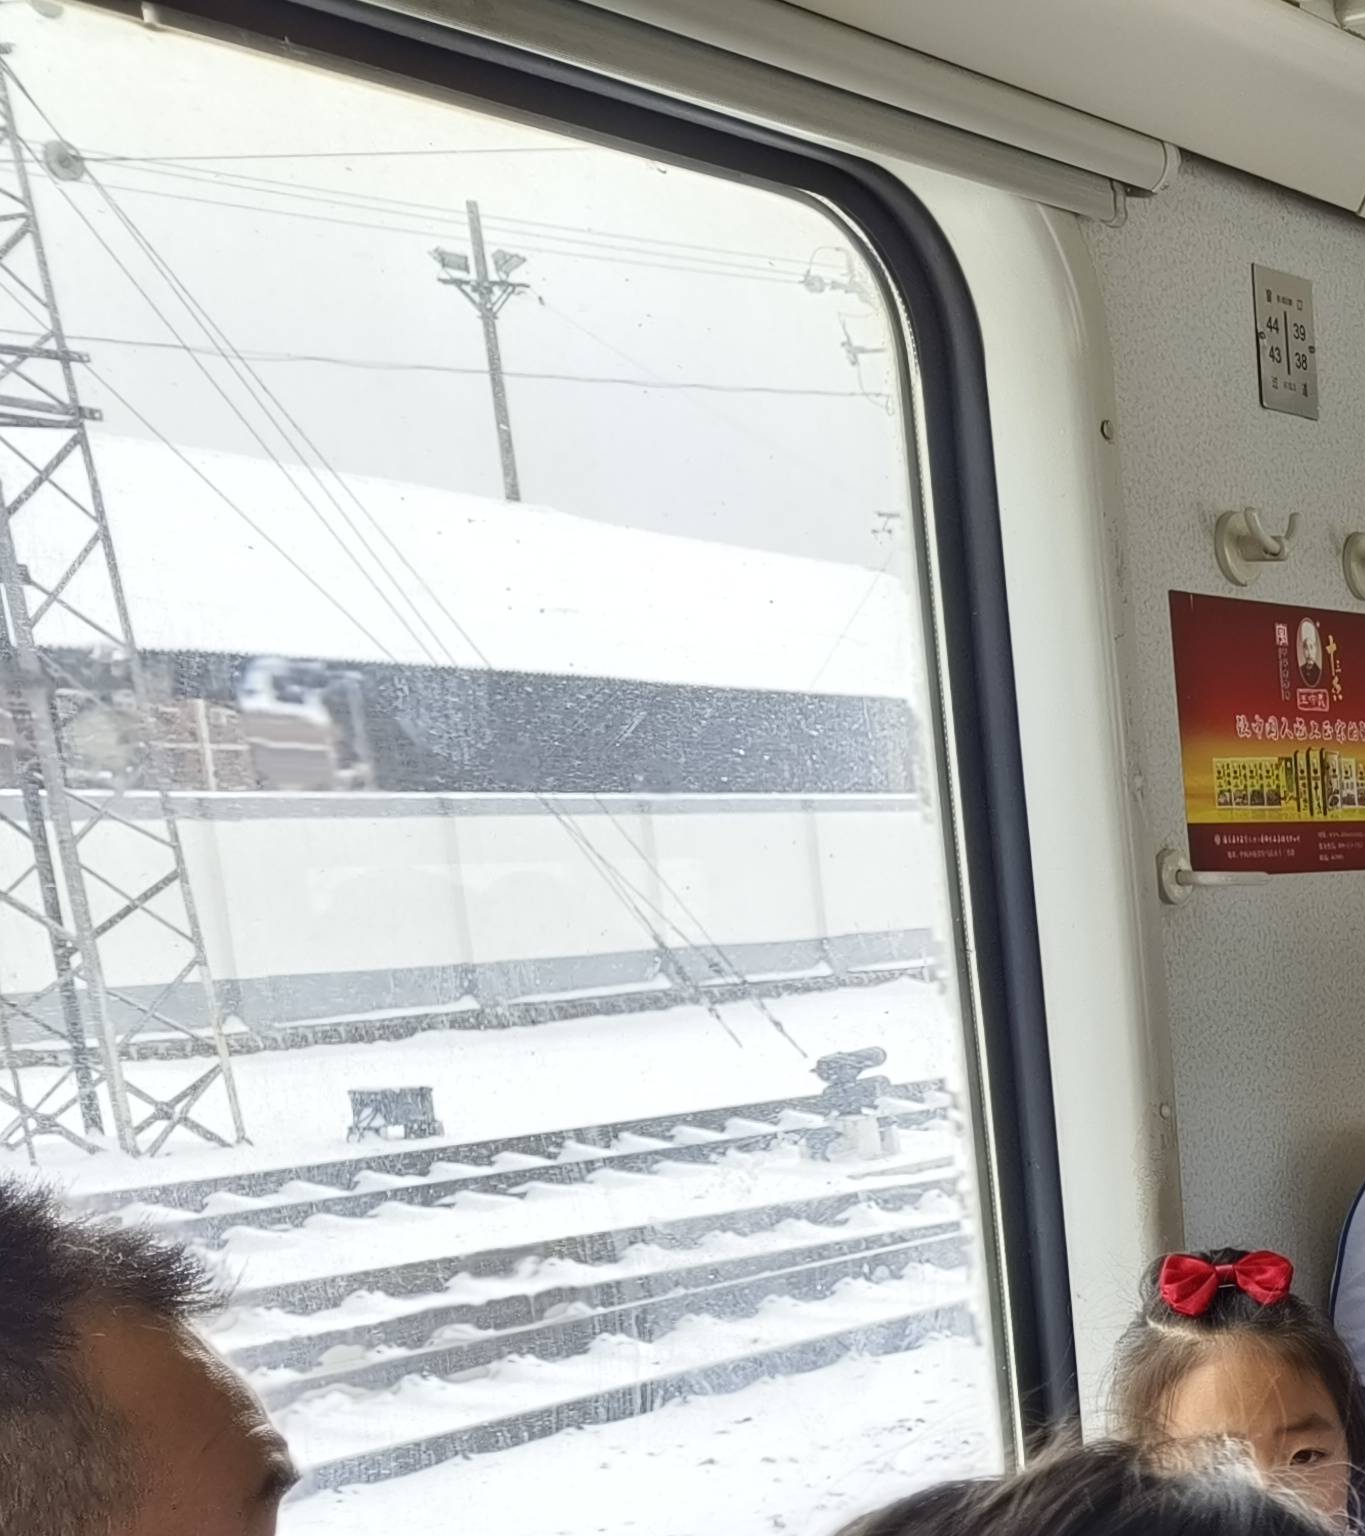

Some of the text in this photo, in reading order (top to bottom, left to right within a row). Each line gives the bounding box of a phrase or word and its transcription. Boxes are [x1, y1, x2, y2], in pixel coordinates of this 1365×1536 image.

[1266, 315, 1280, 335] 44
[1293, 323, 1306, 342] 39
[1269, 345, 1281, 364] 43
[1294, 352, 1308, 371] 38
